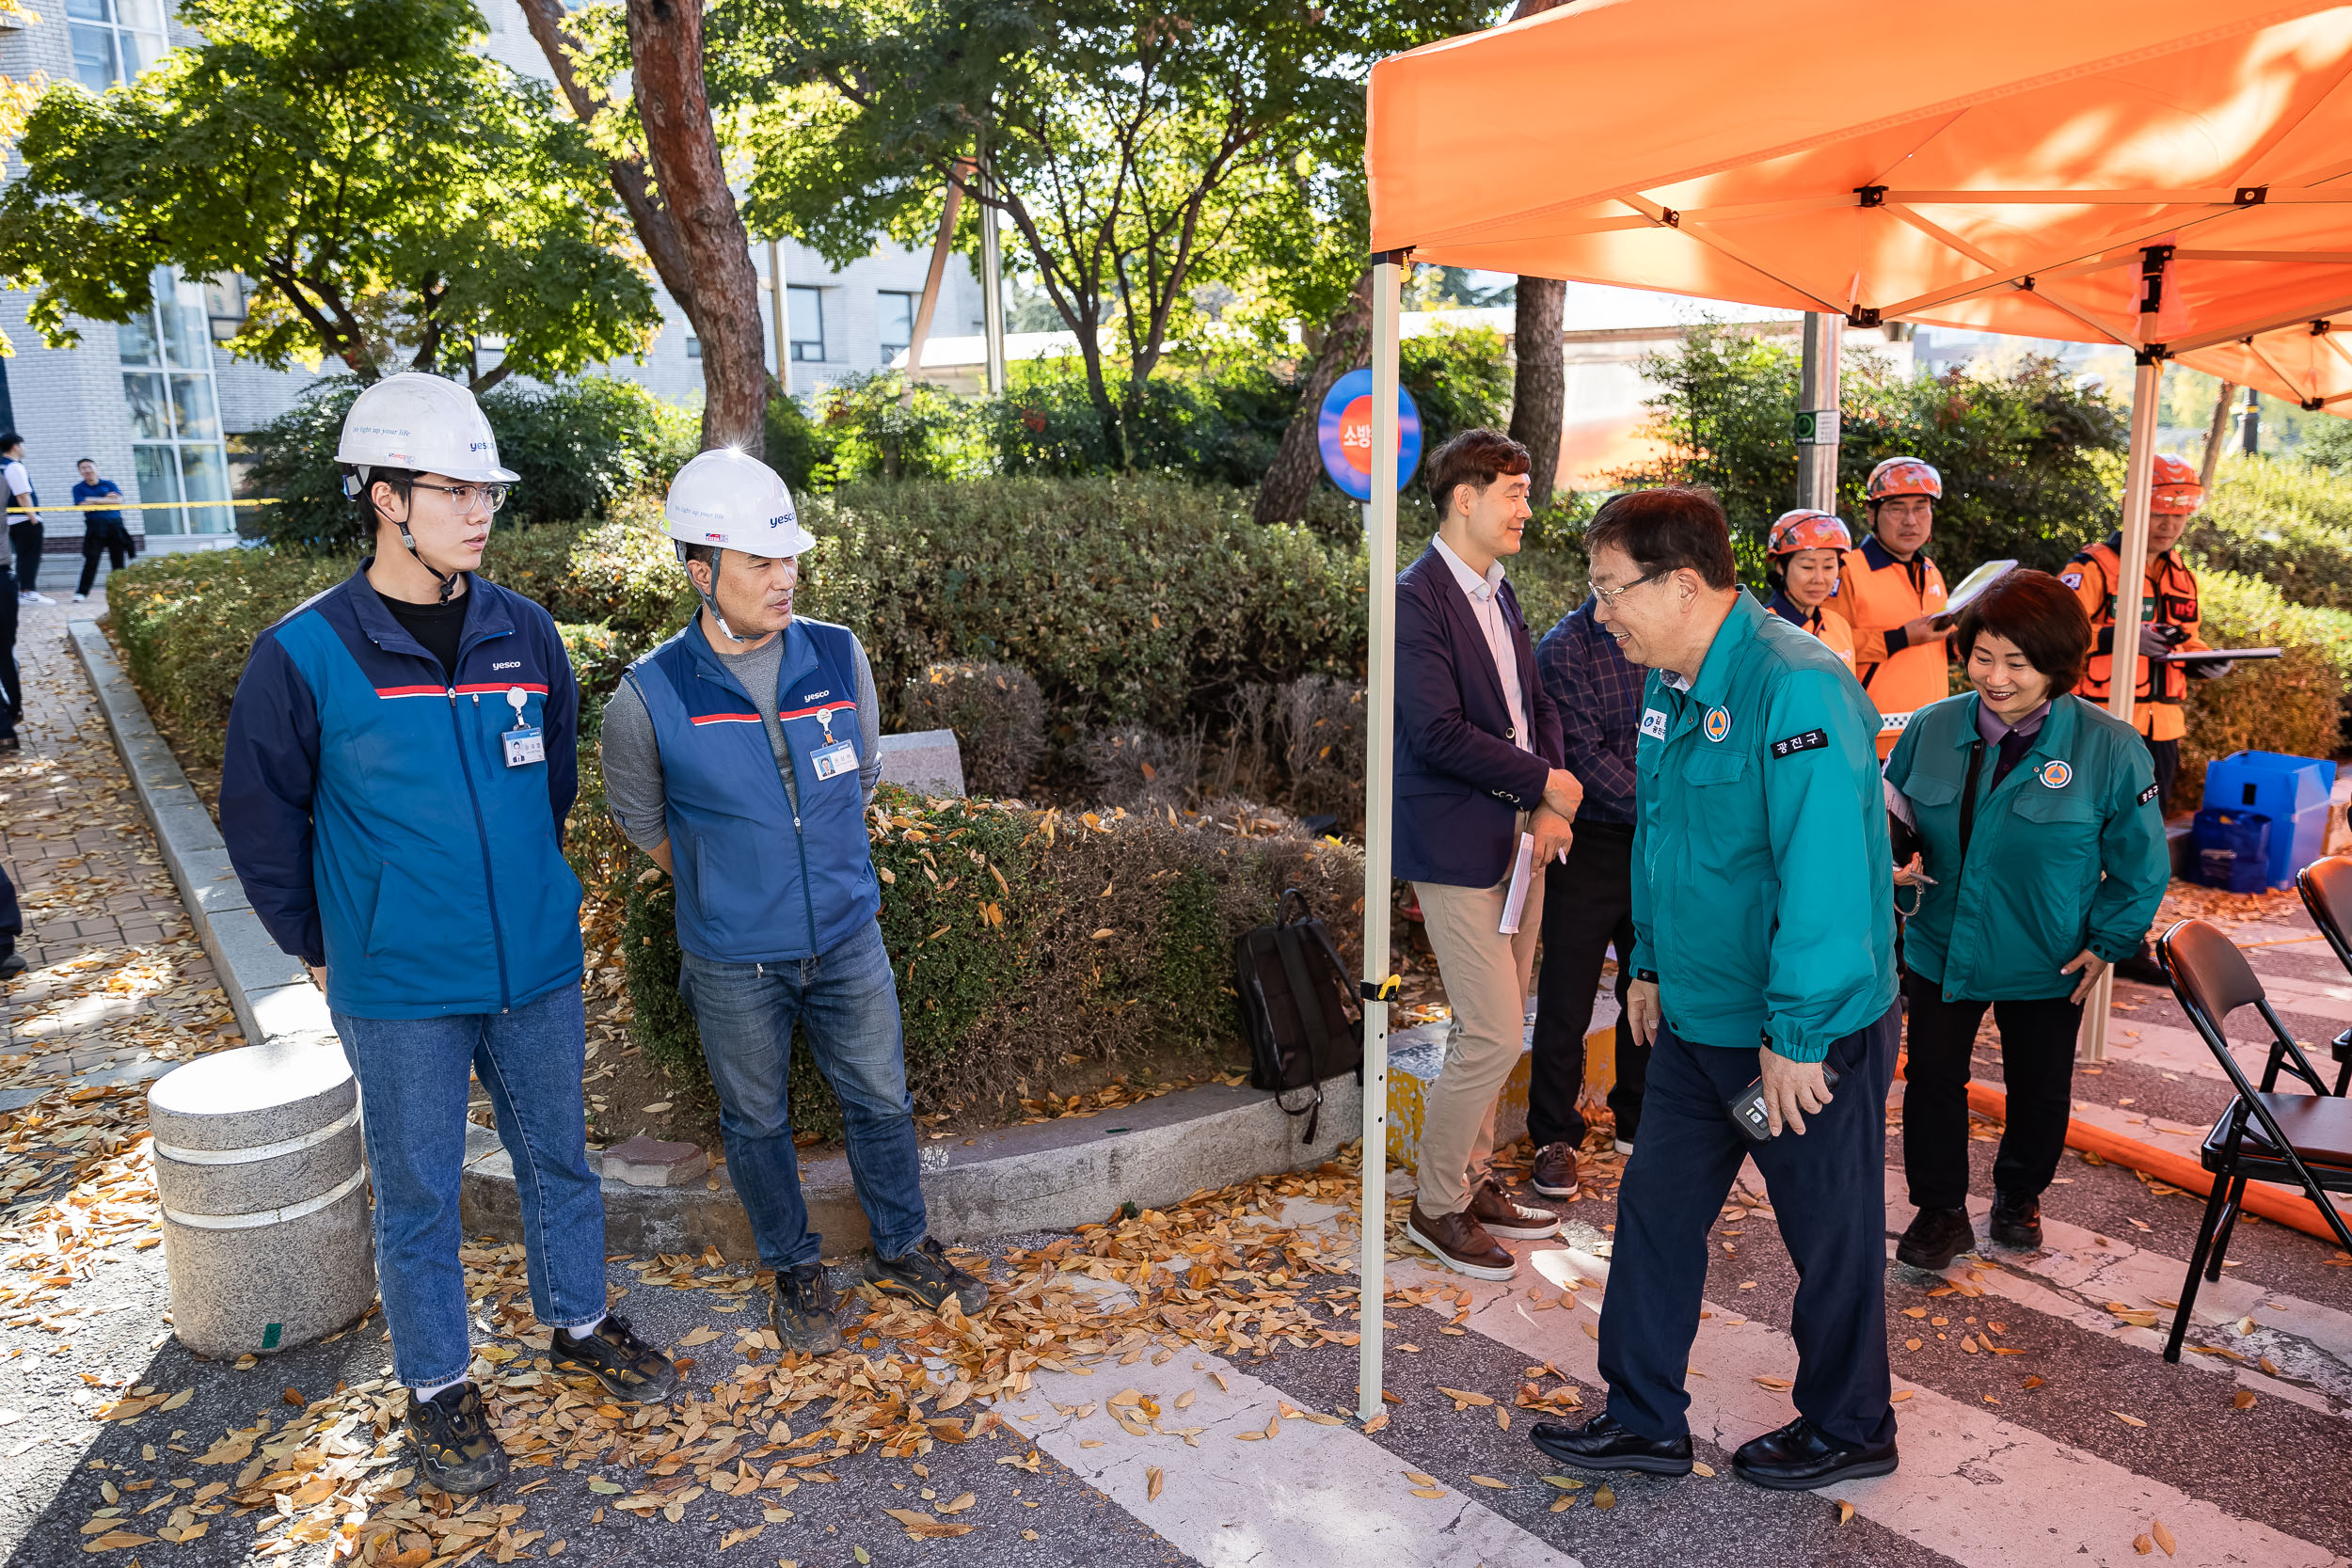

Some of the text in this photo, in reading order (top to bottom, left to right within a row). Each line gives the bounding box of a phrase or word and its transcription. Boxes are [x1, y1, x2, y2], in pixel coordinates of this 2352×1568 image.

[470, 442, 494, 452] yesco
[770, 512, 795, 528] yesco
[493, 660, 521, 671] yesco
[804, 689, 829, 703] yesco
[1777, 732, 1818, 754] 광진구
